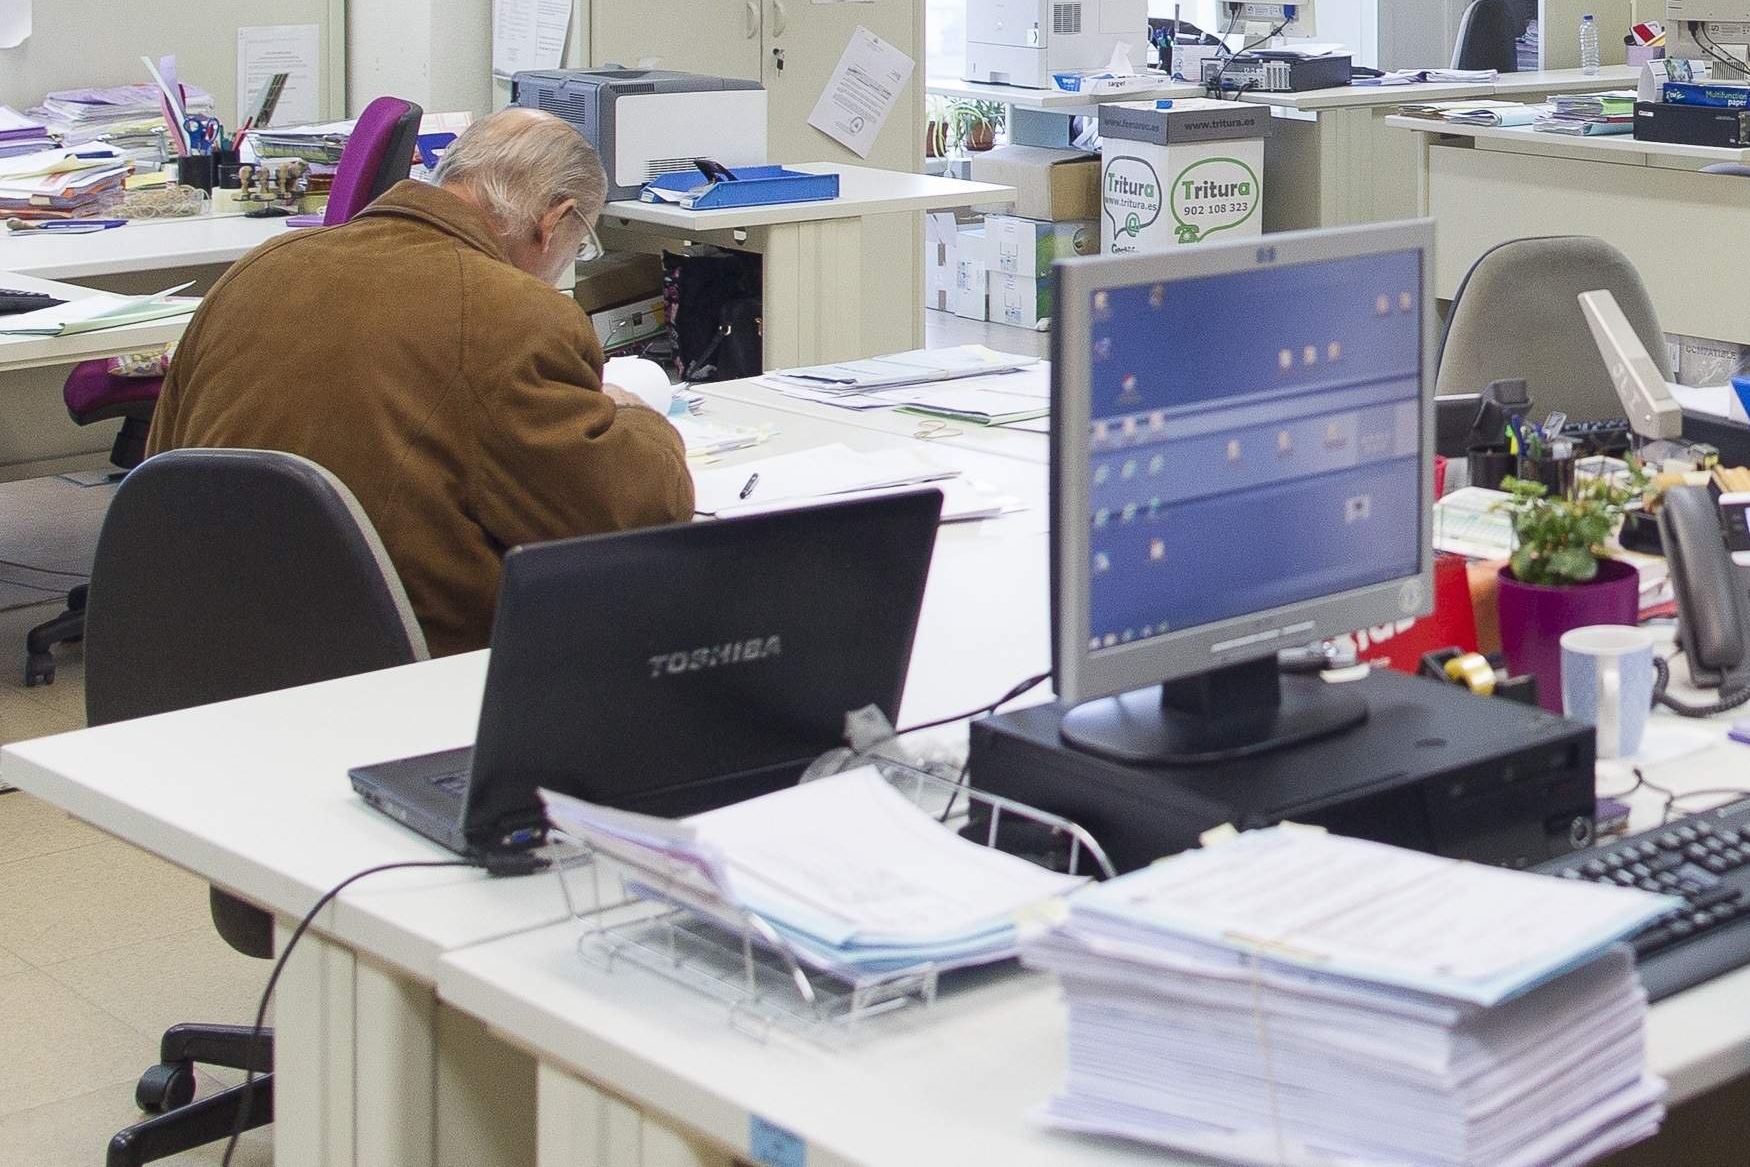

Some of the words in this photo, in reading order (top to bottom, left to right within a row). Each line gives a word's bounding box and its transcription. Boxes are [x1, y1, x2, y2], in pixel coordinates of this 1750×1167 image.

[1704, 89, 1748, 100] Multifunction
[1727, 99, 1748, 107] paper
[1184, 117, 1256, 131] www.tritura.es
[1107, 172, 1155, 198] Tritura
[1182, 180, 1251, 200] Tritura
[1105, 196, 1157, 212] www.tritura.es
[1184, 206, 1203, 216] 902
[1209, 204, 1226, 214] 108
[1229, 202, 1248, 212] 323
[648, 634, 782, 679] TOSHIBA
